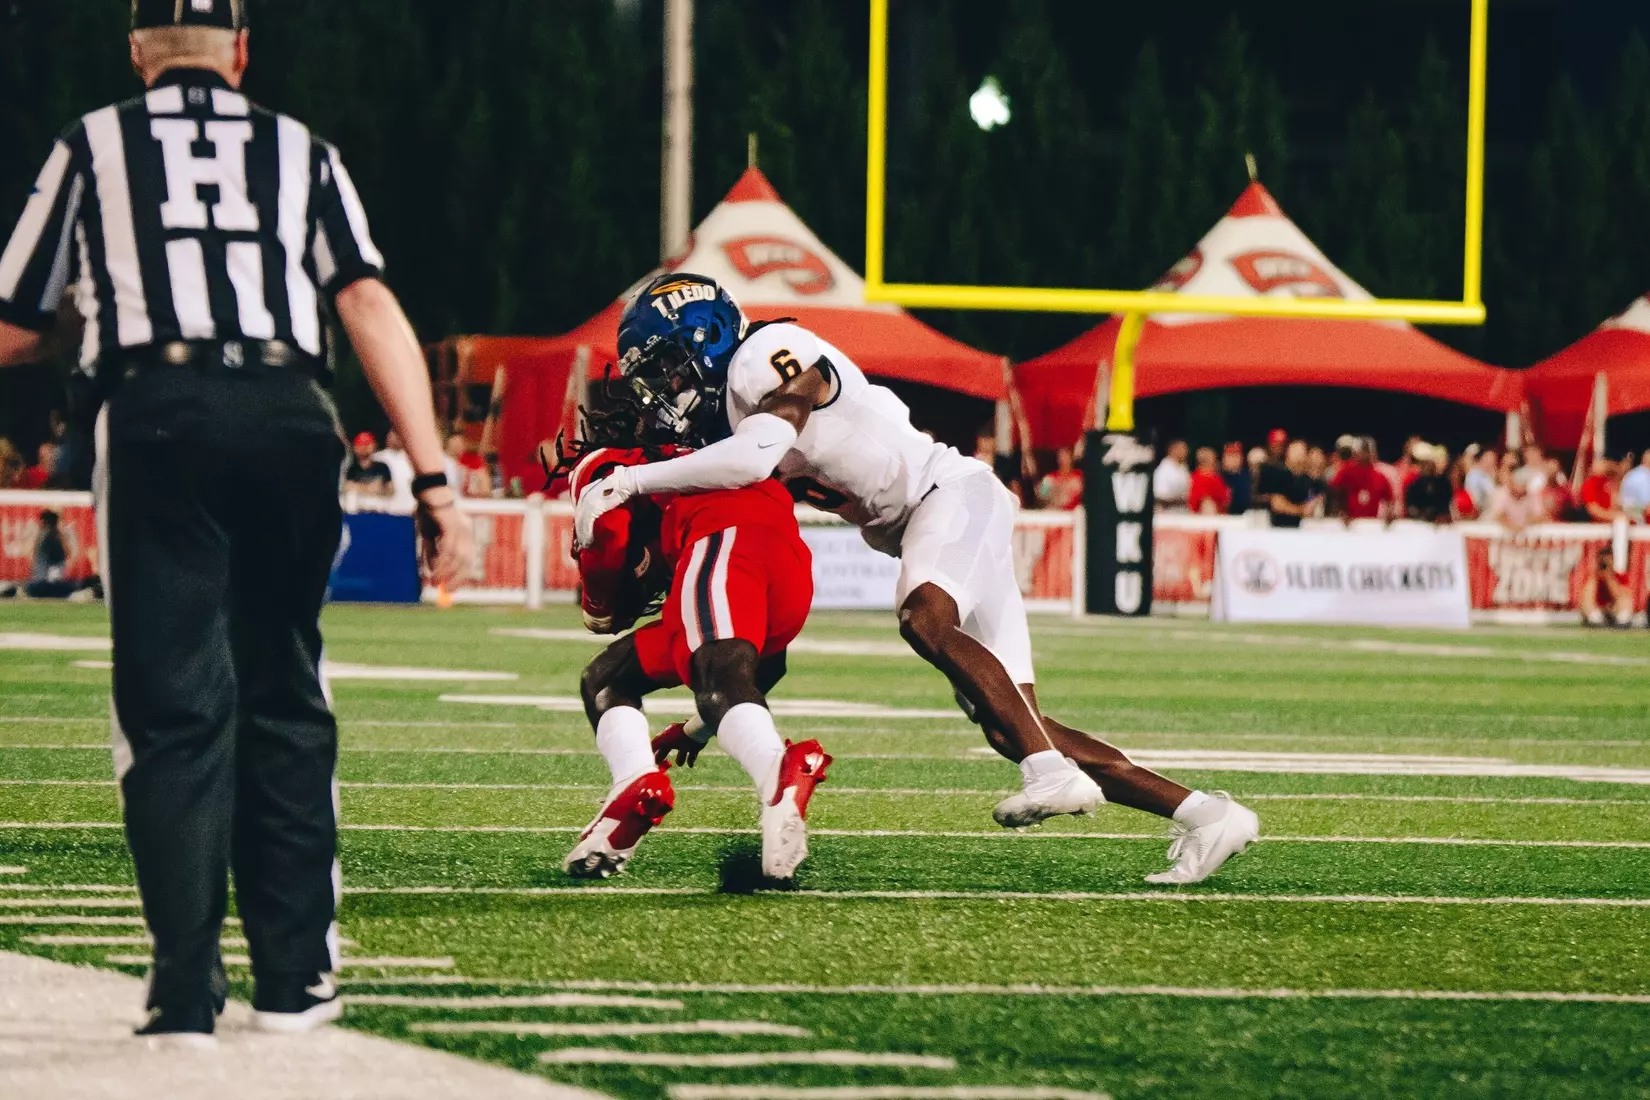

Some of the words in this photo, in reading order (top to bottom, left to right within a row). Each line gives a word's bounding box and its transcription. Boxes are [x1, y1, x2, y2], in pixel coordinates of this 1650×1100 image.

[150, 118, 260, 231] H
[769, 346, 803, 385] 6
[1111, 472, 1149, 614] WKU
